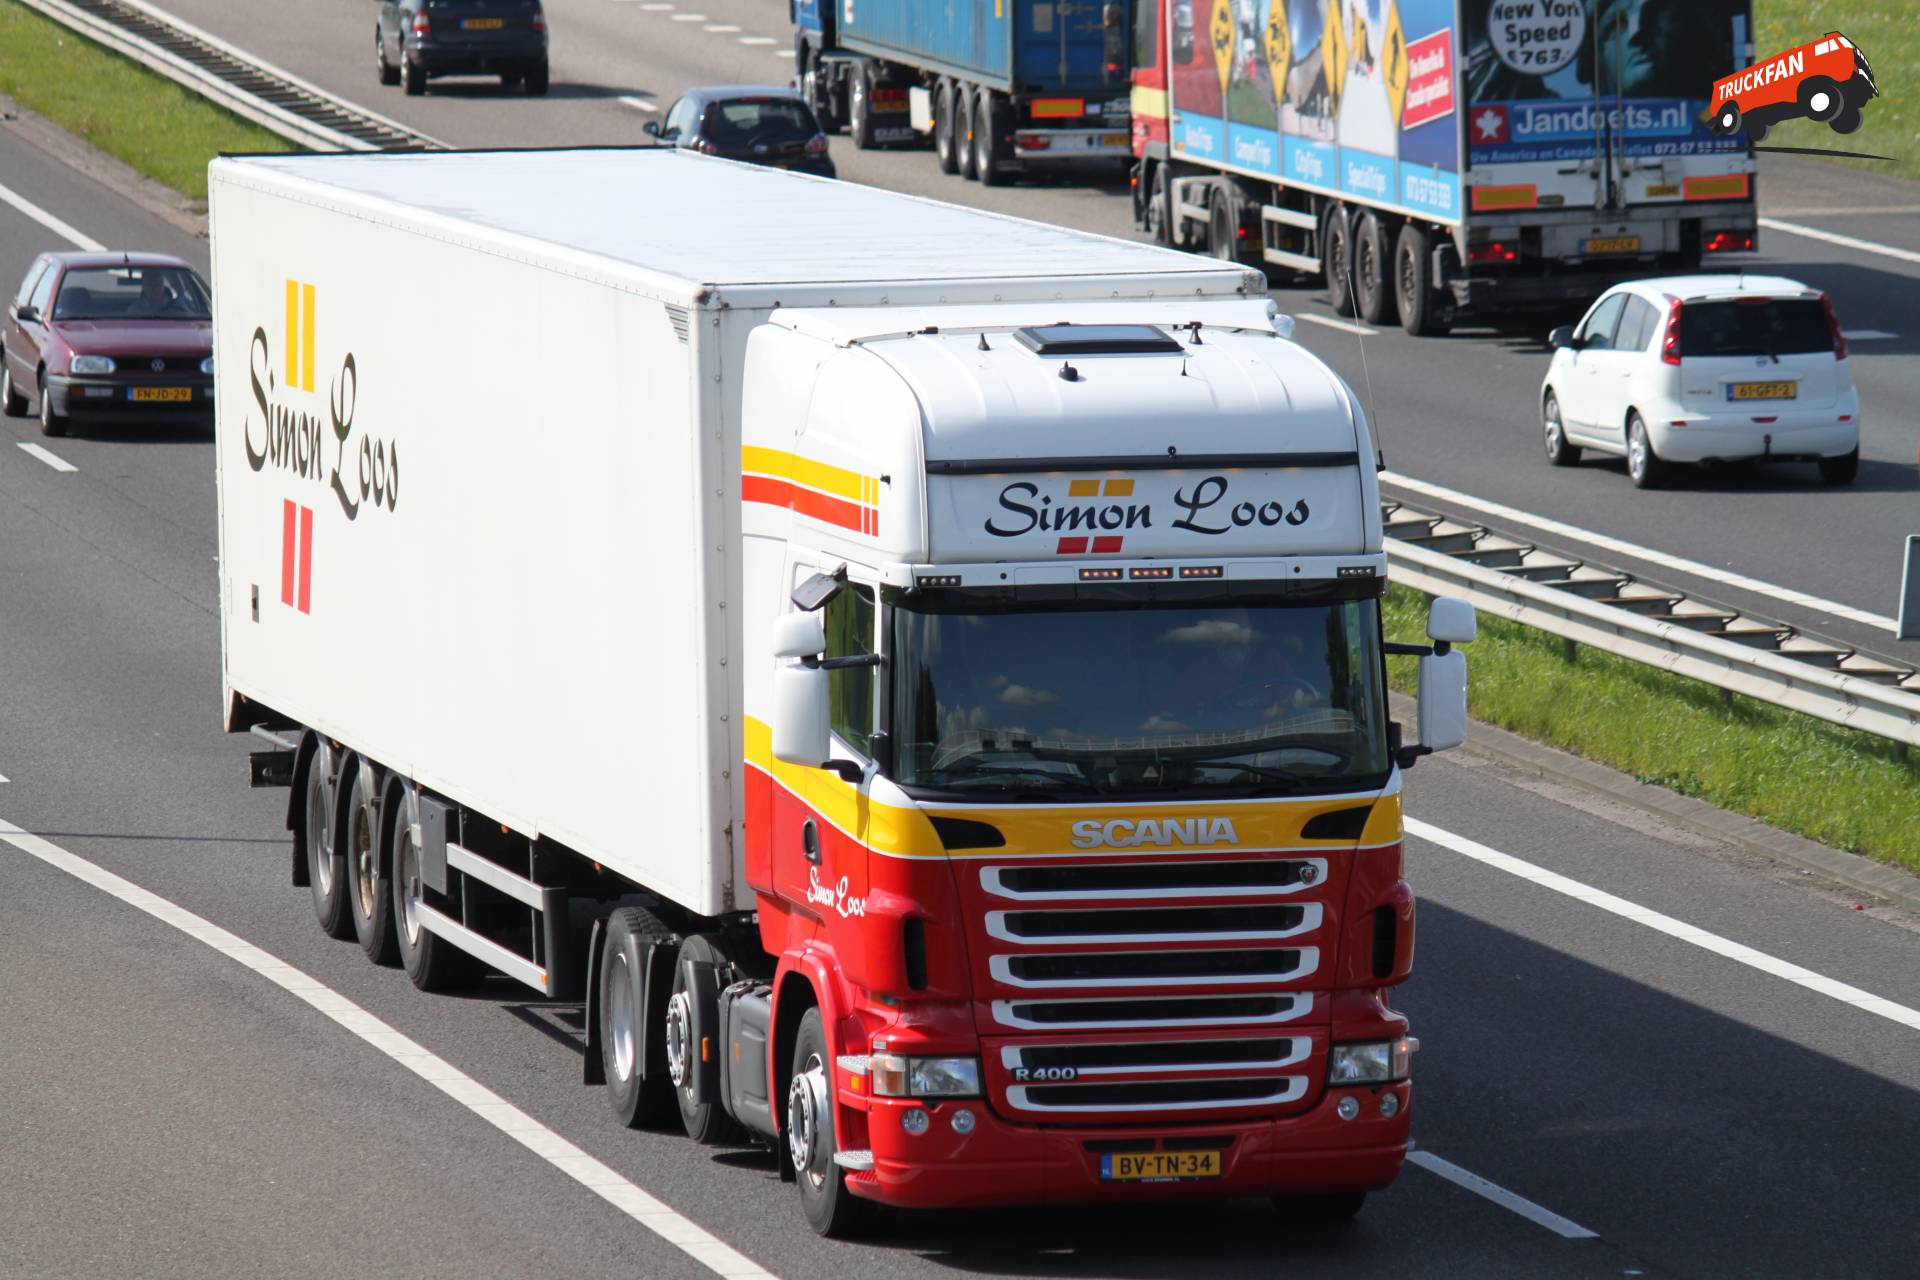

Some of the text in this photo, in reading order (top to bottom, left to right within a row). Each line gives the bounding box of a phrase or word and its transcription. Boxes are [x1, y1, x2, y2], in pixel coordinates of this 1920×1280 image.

[1505, 21, 1570, 47] Speed
[1516, 101, 1687, 134] Jandoets.nl
[245, 326, 399, 521] Simon Loos
[984, 475, 1310, 537] Simon Loos
[1071, 816, 1241, 849] SCANIA
[807, 865, 866, 918] Simon Loos
[1015, 1067, 1075, 1081] R 400
[1120, 1154, 1212, 1175] BV-TN-34
